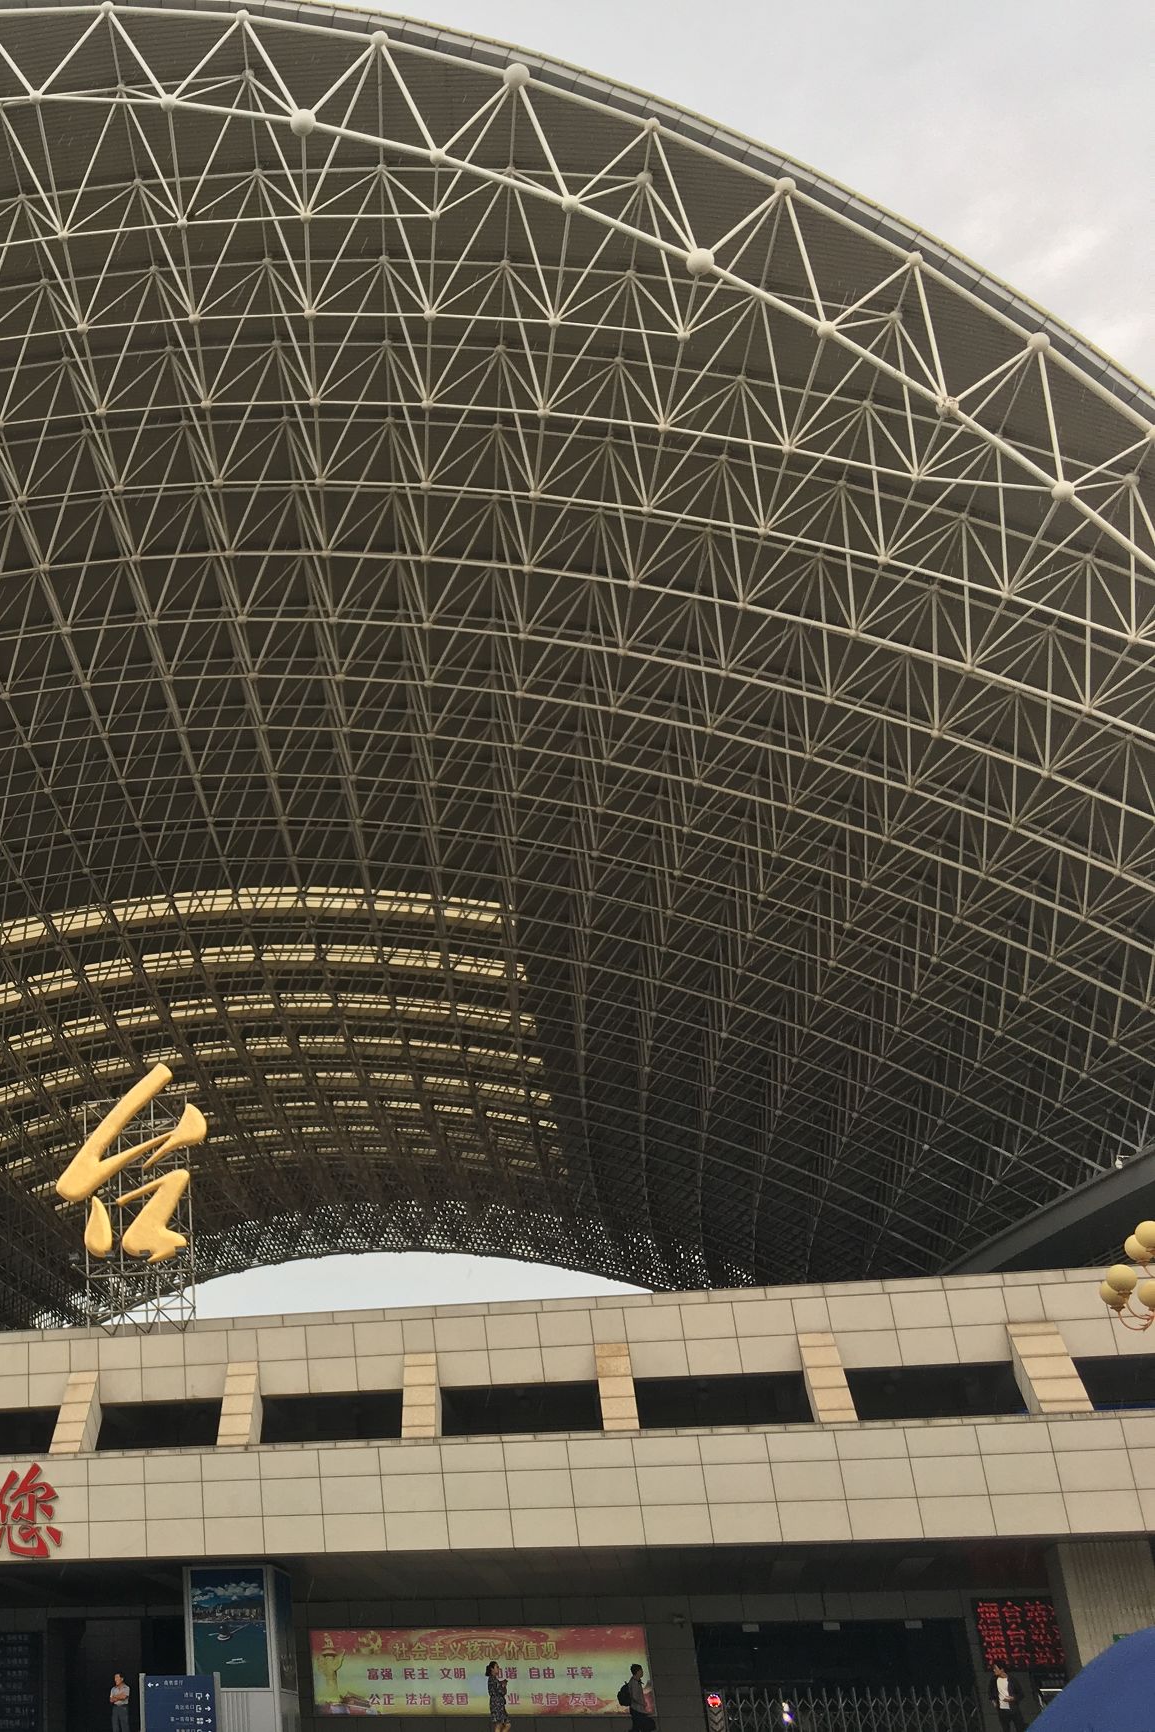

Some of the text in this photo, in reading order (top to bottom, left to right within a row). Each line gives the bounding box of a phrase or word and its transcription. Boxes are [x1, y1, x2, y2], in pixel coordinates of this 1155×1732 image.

[56, 1063, 207, 1263] 台
[392, 1640, 559, 1661] 社会主义核心价值观
[367, 1667, 393, 1680] 富强
[404, 1667, 429, 1680] 民主
[440, 1667, 466, 1680] 文明
[528, 1667, 555, 1679] 自由
[566, 1666, 594, 1679] 平等
[369, 1693, 395, 1706] 公正
[406, 1693, 431, 1706] 法治
[442, 1693, 468, 1706] 爱国
[531, 1693, 559, 1706] 诚信
[569, 1693, 598, 1706] 友善
